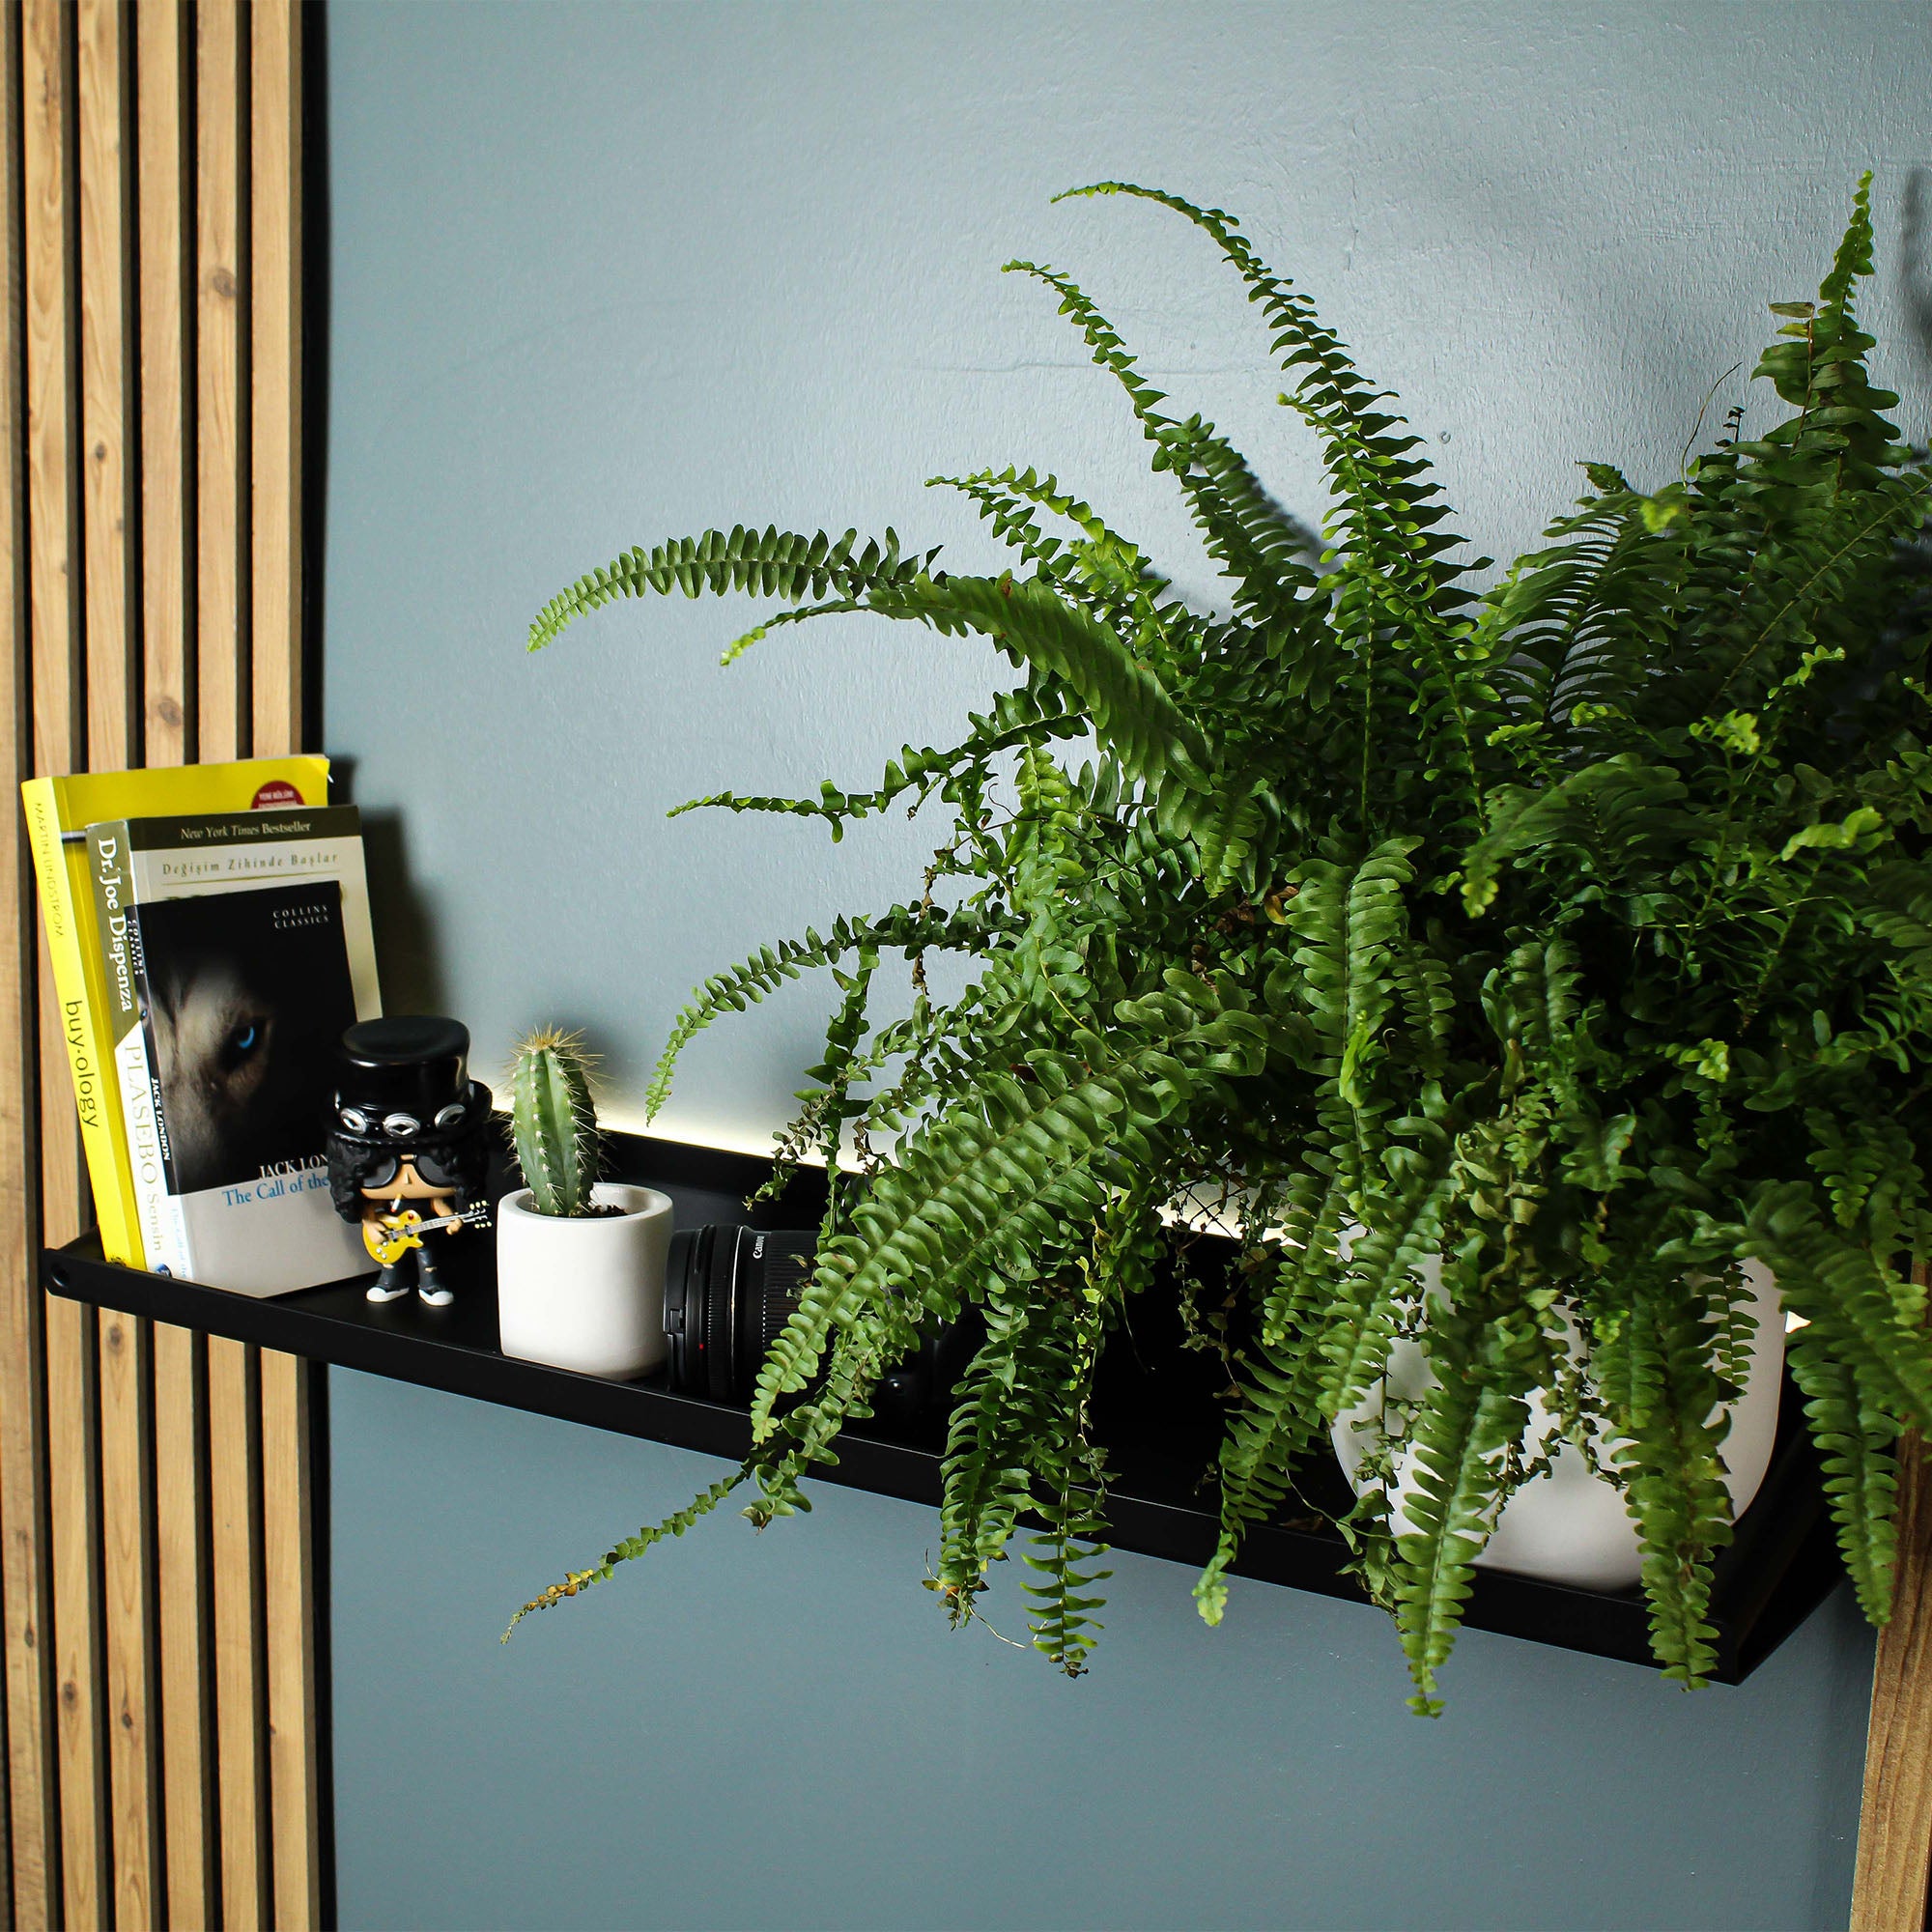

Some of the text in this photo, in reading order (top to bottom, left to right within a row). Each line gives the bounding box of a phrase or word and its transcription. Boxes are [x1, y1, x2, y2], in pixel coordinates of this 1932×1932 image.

[181, 821, 311, 839] New York Times Bestseller
[35, 803, 64, 936] MARTIN LINDSTROM
[162, 852, 338, 878] Değişim Zihinde Başlar
[98, 837, 133, 1012] Dr. Joe Dispenza
[272, 904, 328, 919] COLLINS
[274, 915, 329, 928] CLASSICS
[132, 919, 145, 975] COLLINS
[151, 1077, 171, 1161] JACK LONDON
[125, 1043, 163, 1252] PLASEBO Sensin
[259, 1159, 298, 1179] JACK
[222, 1173, 330, 1207] The Call of the
[753, 1236, 764, 1259] Canon
